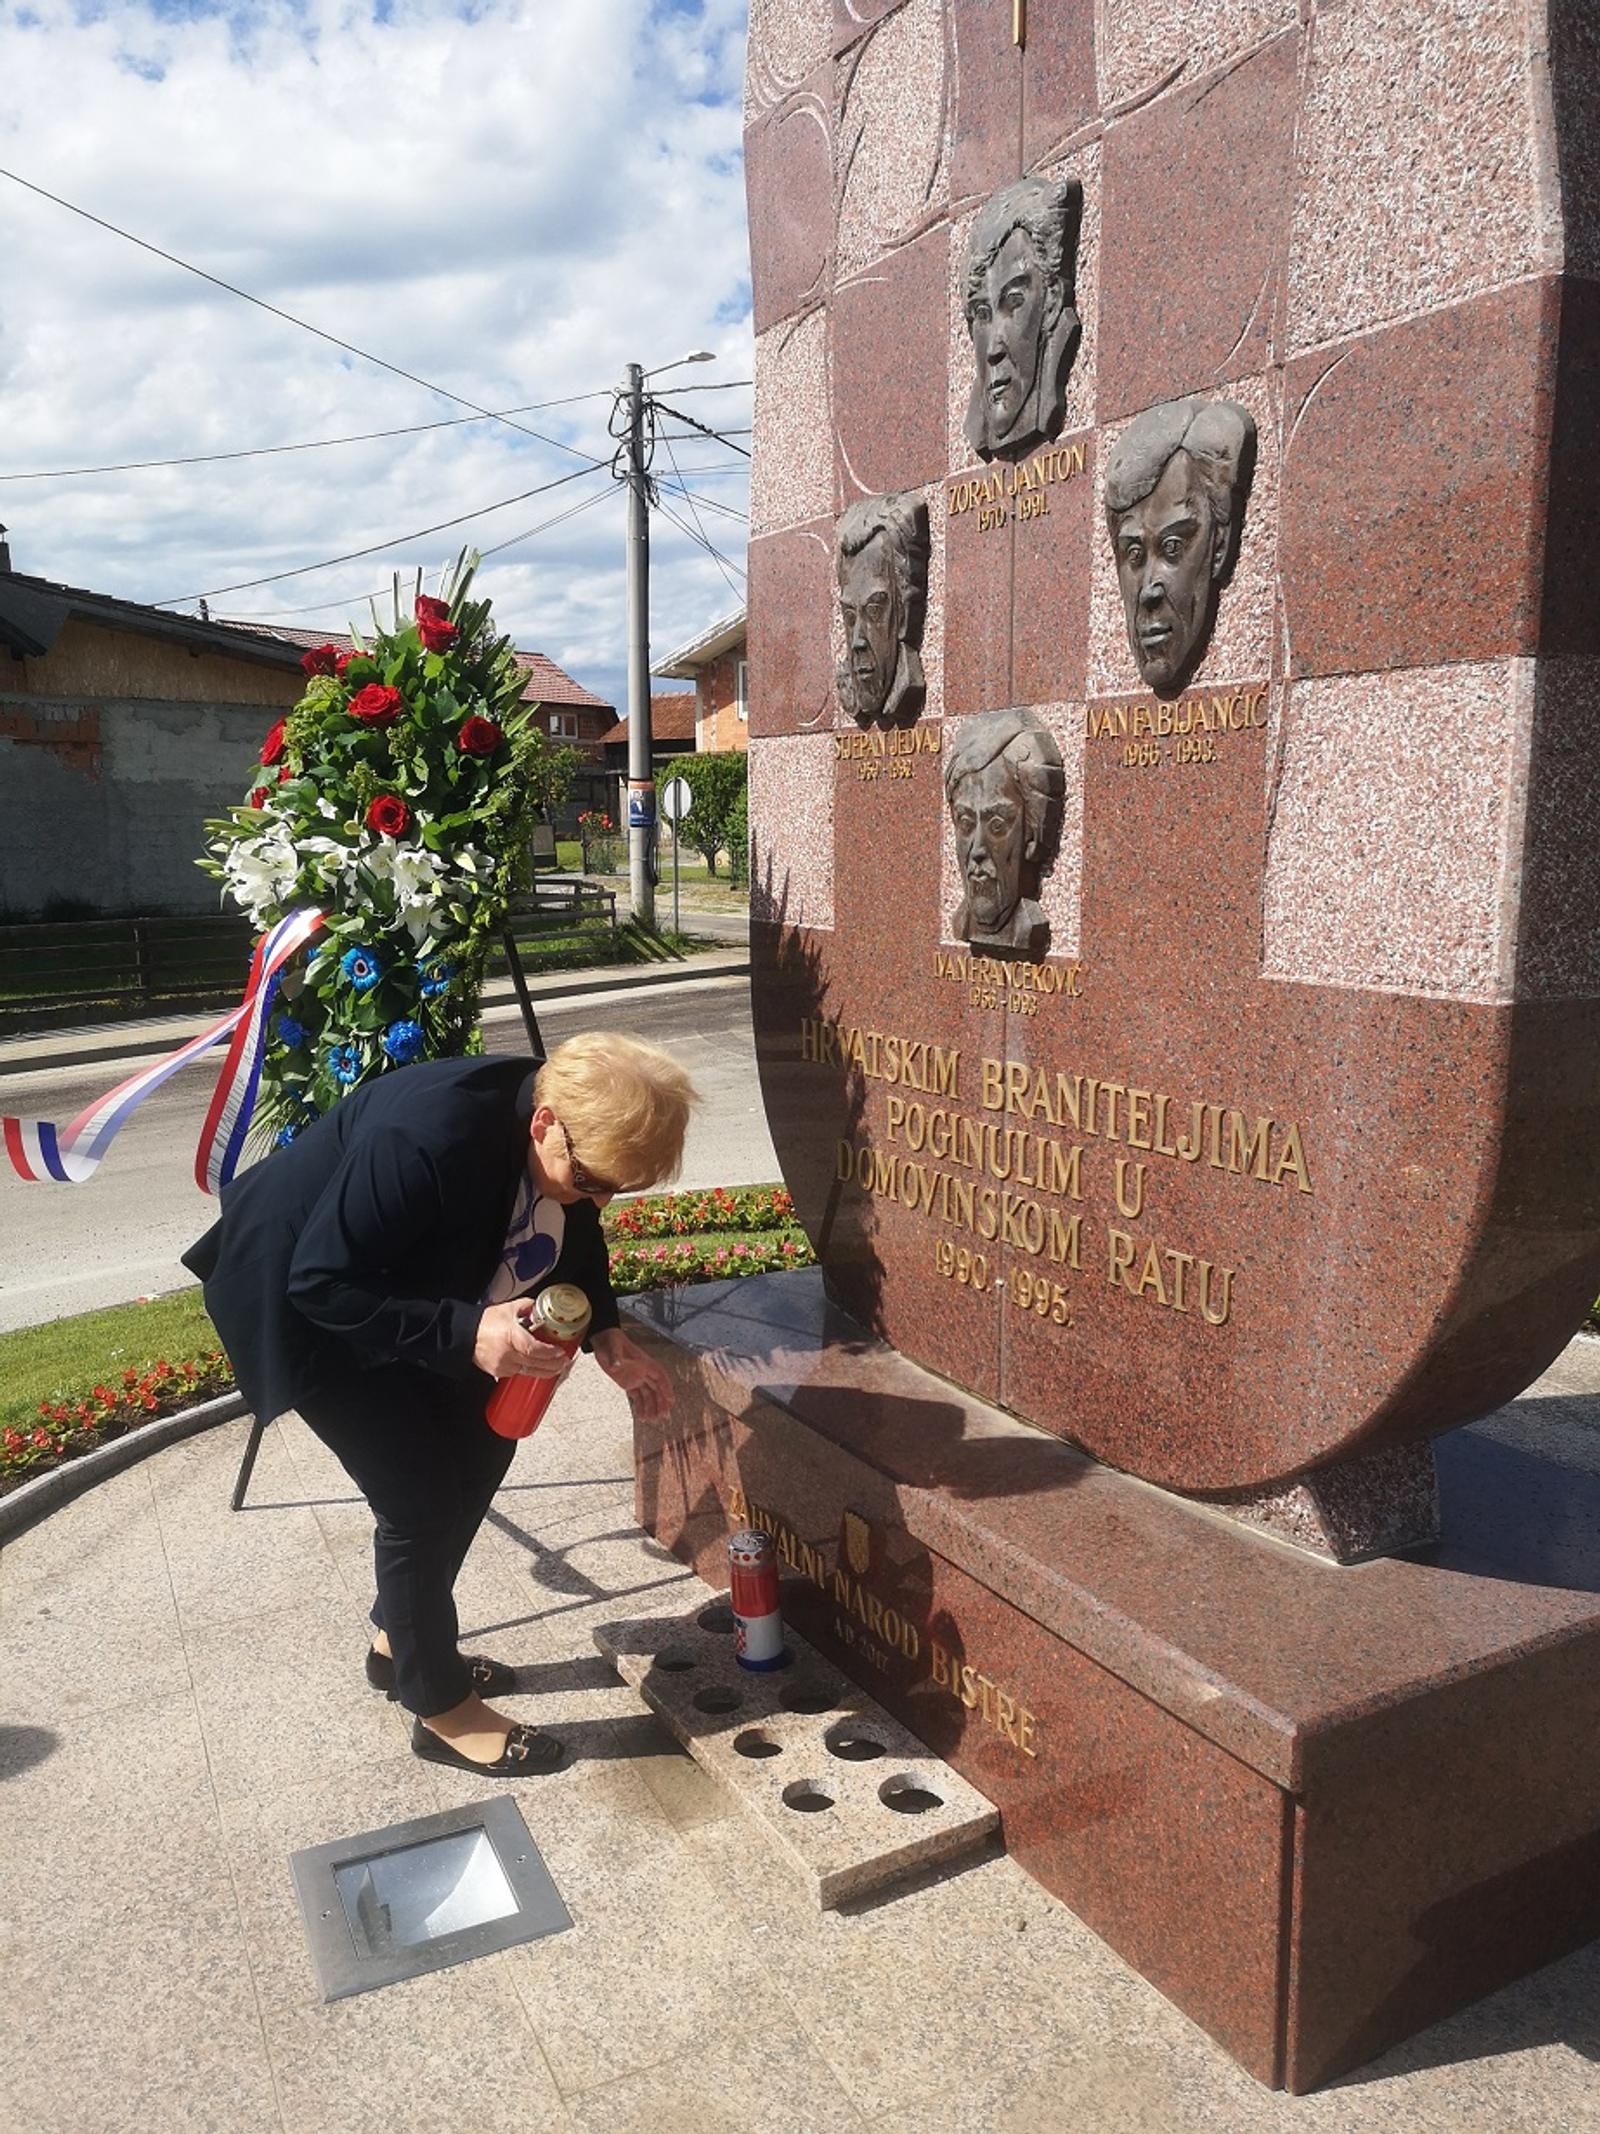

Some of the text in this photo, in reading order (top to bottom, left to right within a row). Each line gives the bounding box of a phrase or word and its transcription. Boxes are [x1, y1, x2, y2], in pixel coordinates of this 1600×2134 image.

[949, 442, 1087, 516] ZORAN JANTON
[1085, 681, 1269, 739] IVAN FABIJANČIĆ
[800, 1016, 1314, 1194] HRVATSKIM BRANITELJIMA
[886, 1095, 1147, 1220] POGINULIM U
[836, 1138, 1236, 1326] DOMOVINSKOM RATU
[935, 1236, 992, 1294] 1990.
[1009, 1265, 1076, 1329] 1995.
[728, 1485, 1038, 1759] ZAHVALNI NAROD BISTRE
